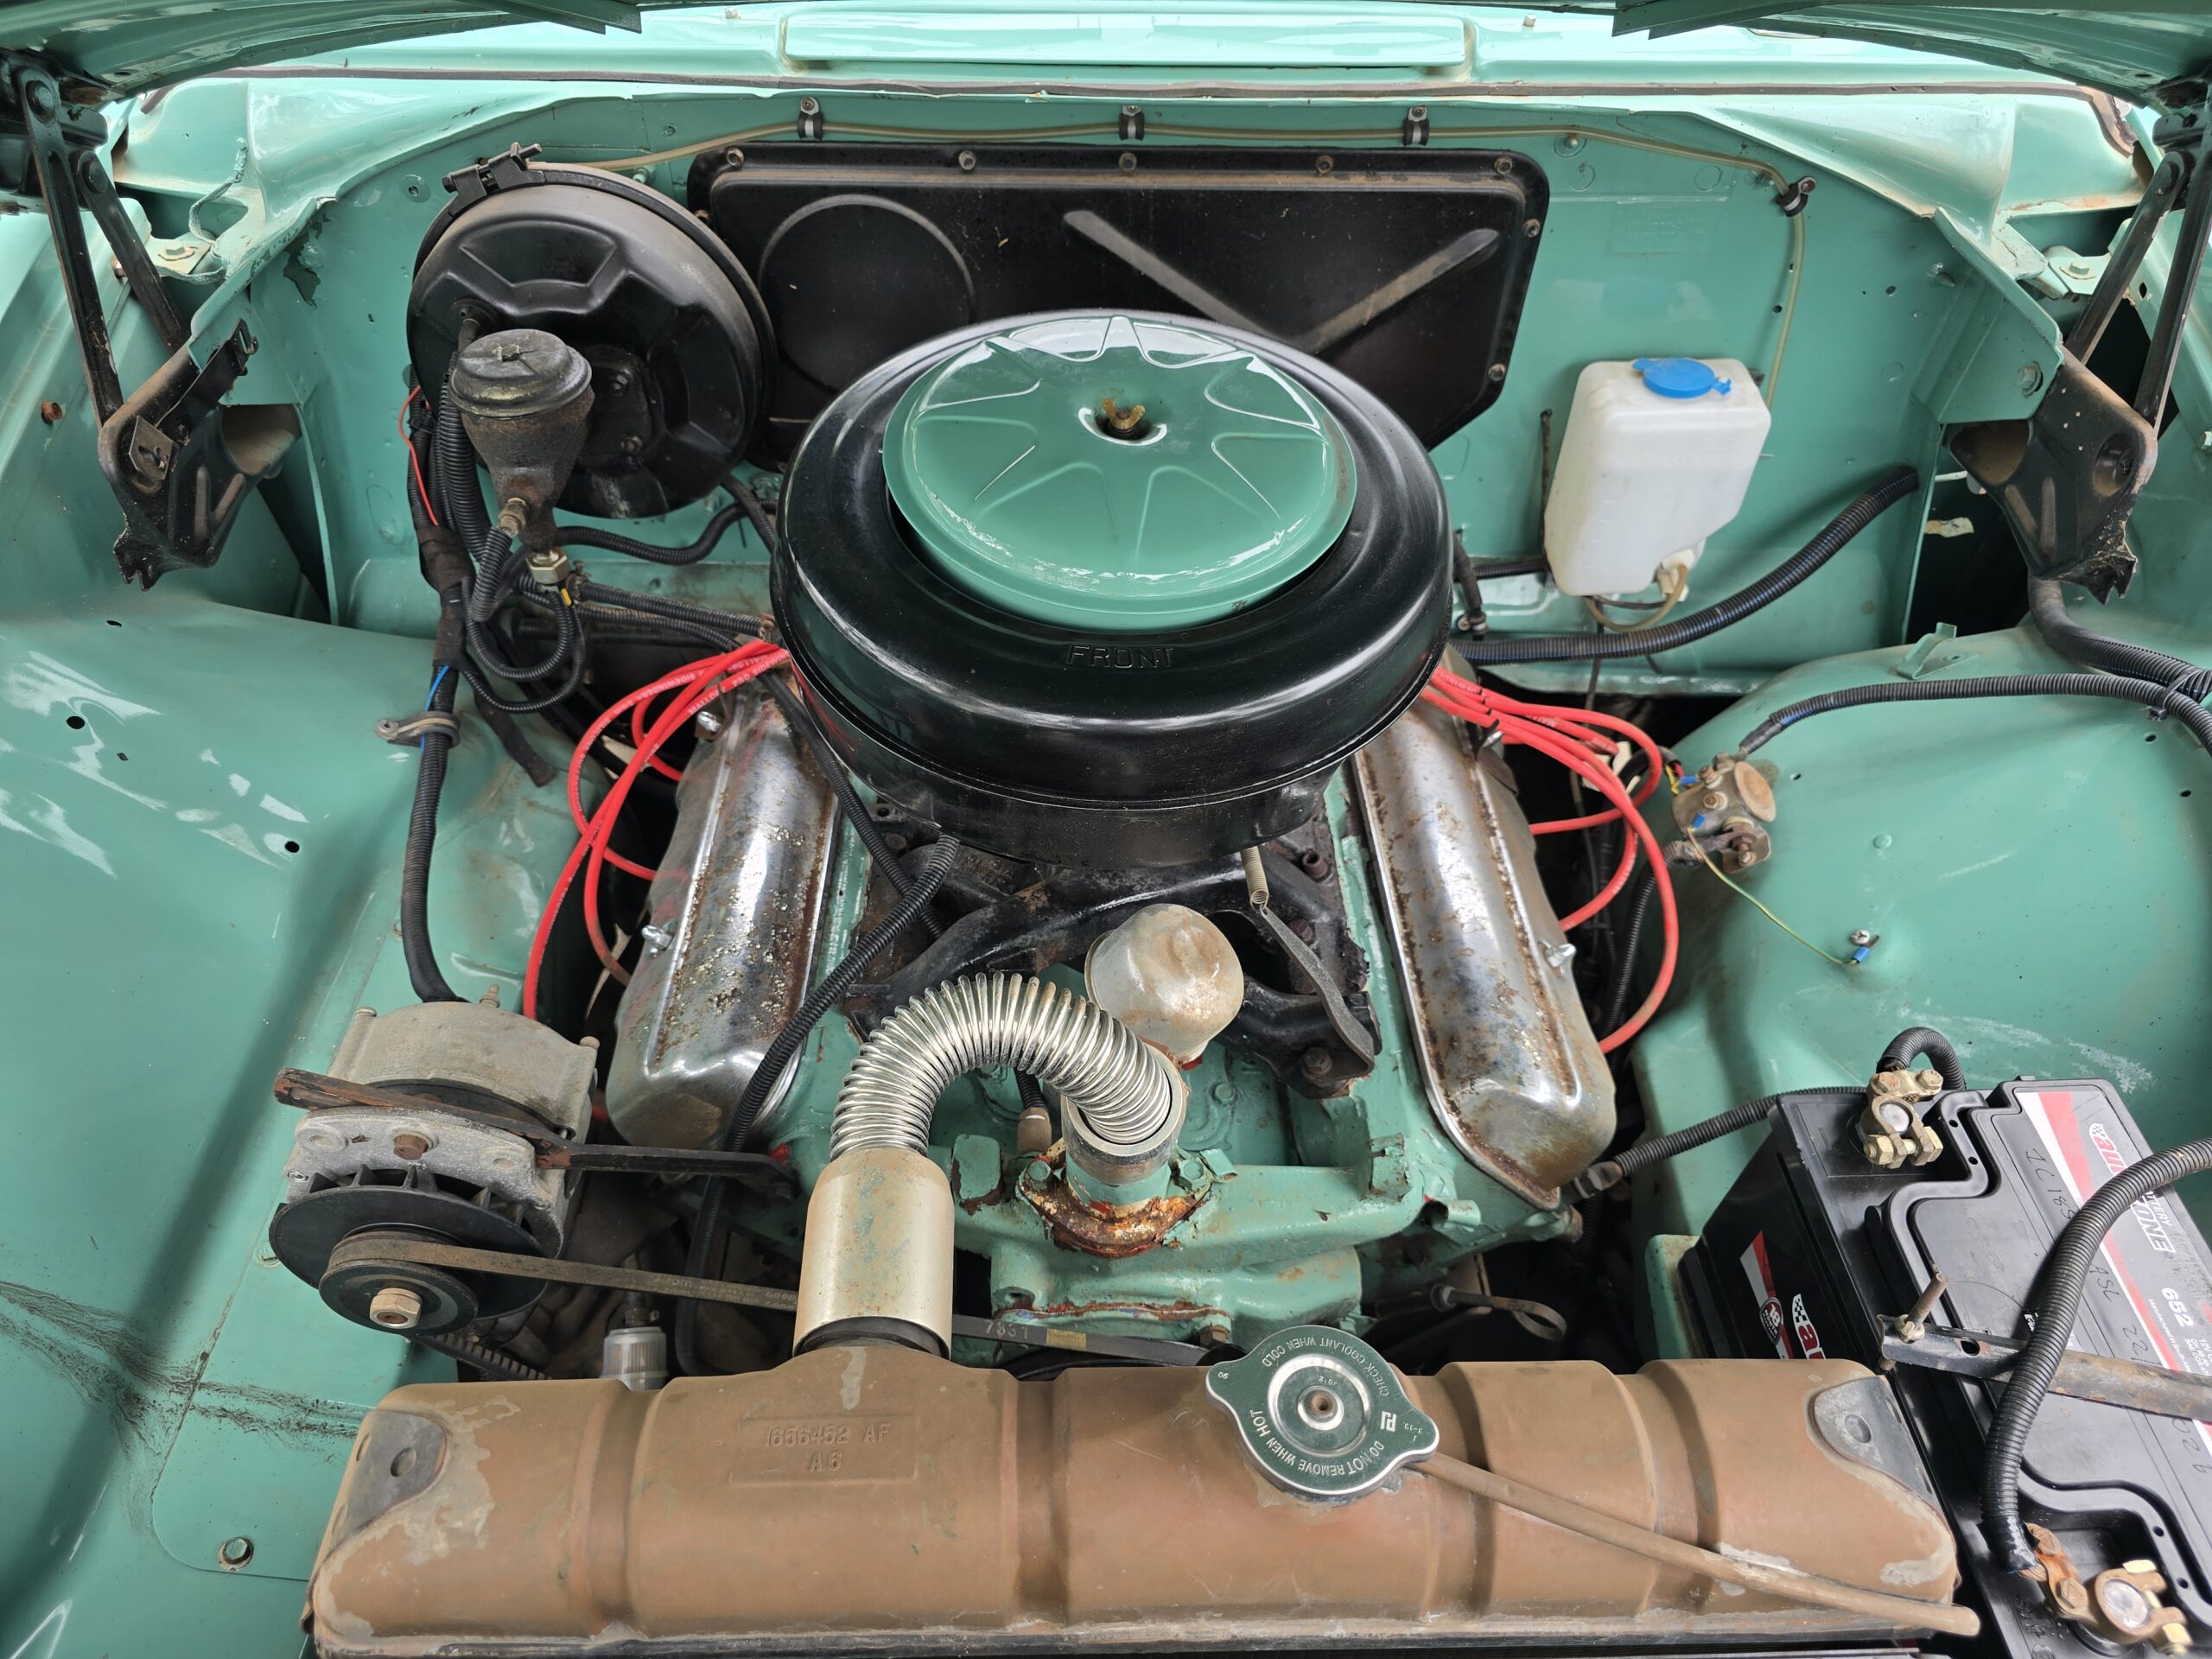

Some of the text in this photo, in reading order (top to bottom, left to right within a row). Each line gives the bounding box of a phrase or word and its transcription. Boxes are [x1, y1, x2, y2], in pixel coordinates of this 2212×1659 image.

[1066, 645, 1173, 669] FRONT
[1770, 1304, 1780, 1327] 18
[2162, 1288, 2194, 1326] 652
[1262, 1336, 1389, 1396] CHECK COOLANT WHEN COLD
[1249, 1409, 1385, 1477] DO NOT REMOVE WHEN HOT
